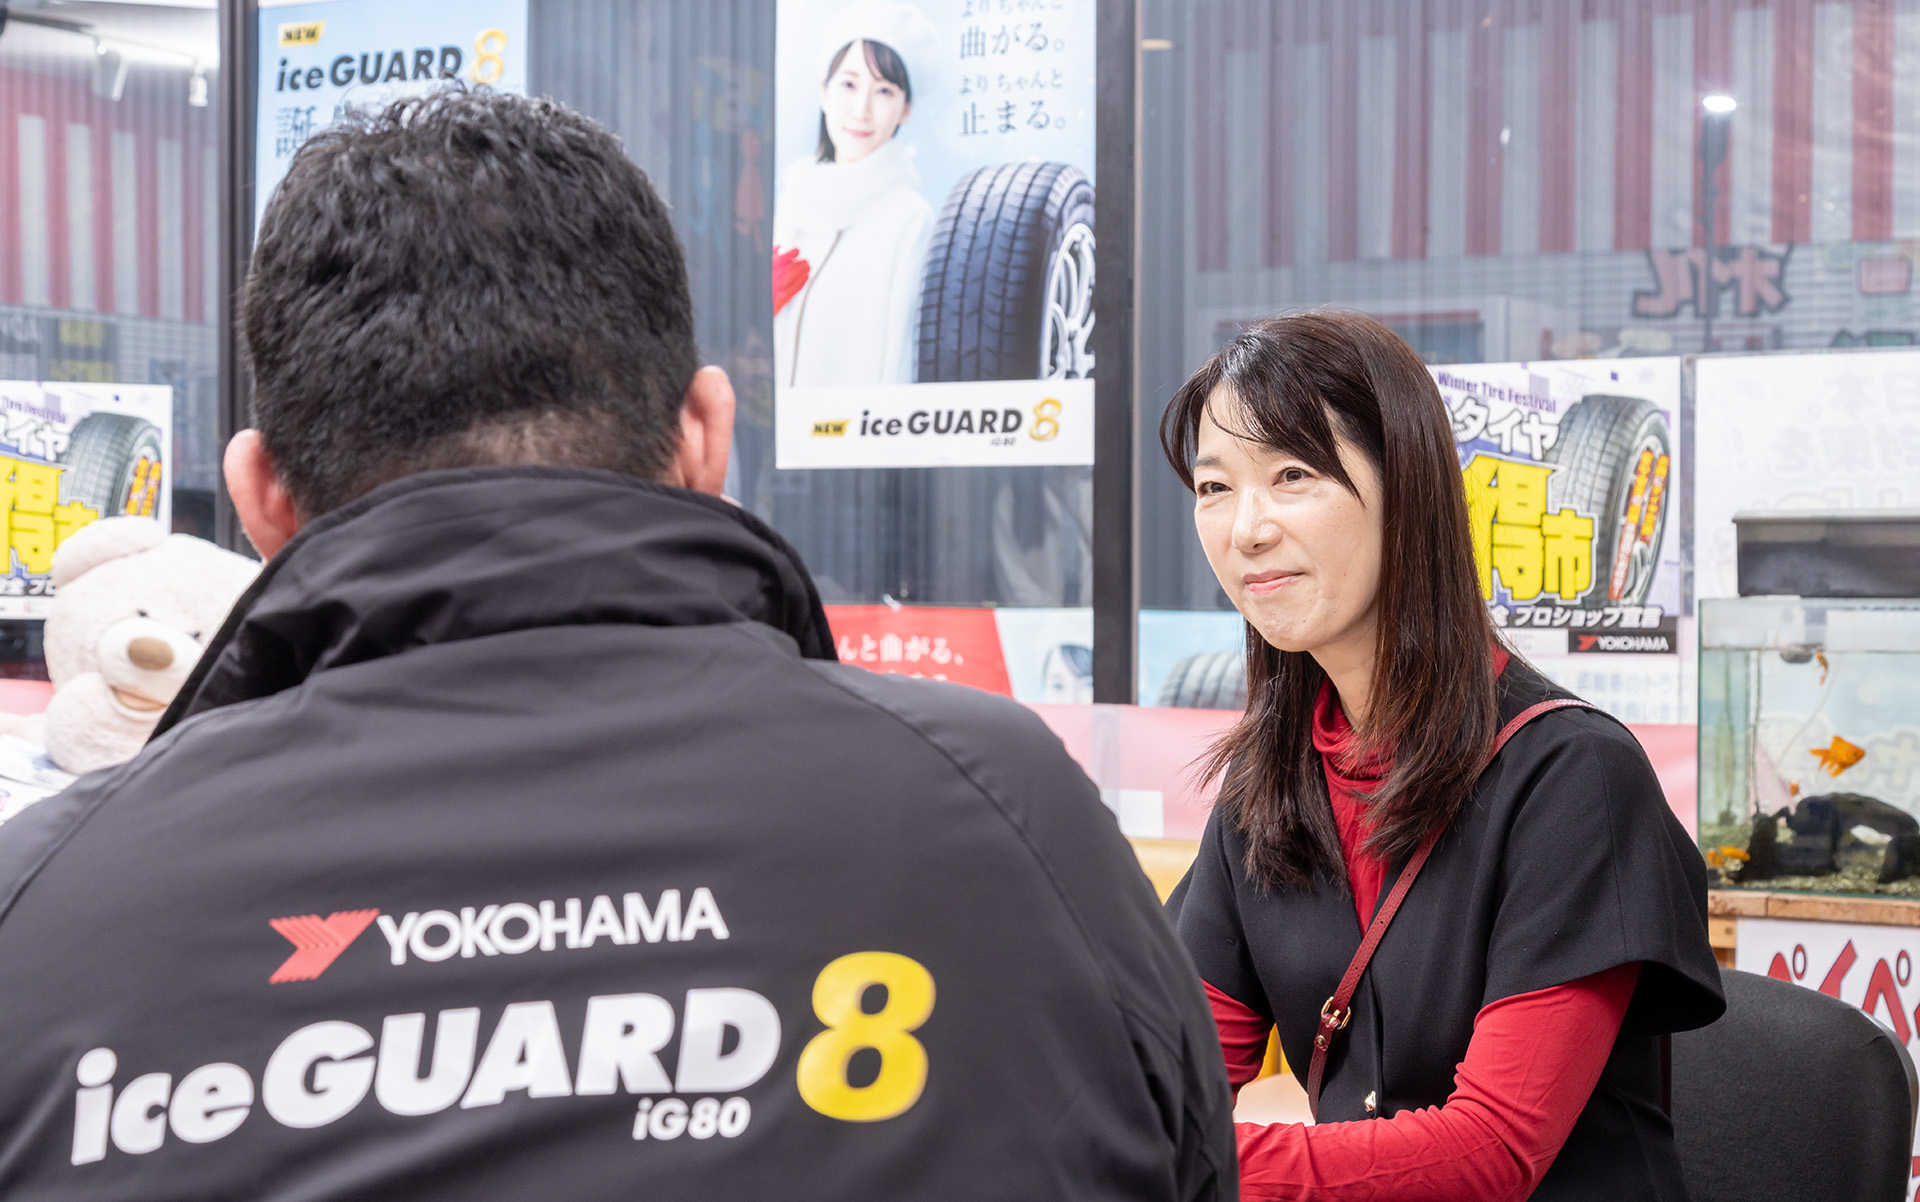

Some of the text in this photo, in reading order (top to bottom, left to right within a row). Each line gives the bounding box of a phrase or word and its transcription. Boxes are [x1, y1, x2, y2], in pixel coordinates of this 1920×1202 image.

[283, 26, 318, 43] NEW
[960, 22, 1065, 58] 曲がる。
[470, 28, 508, 85] 8
[960, 67, 1063, 95] よりちゃんと
[960, 99, 1066, 136] 止まる。
[1437, 371, 1557, 414] Winter Tire Festival
[812, 423, 846, 433] NEW
[1028, 397, 1062, 441] 8
[1597, 635, 1669, 651] YOKOHAMA
[375, 886, 731, 966] YOKOHAMA
[796, 950, 937, 1123] 8
[631, 1097, 754, 1142] iG80
